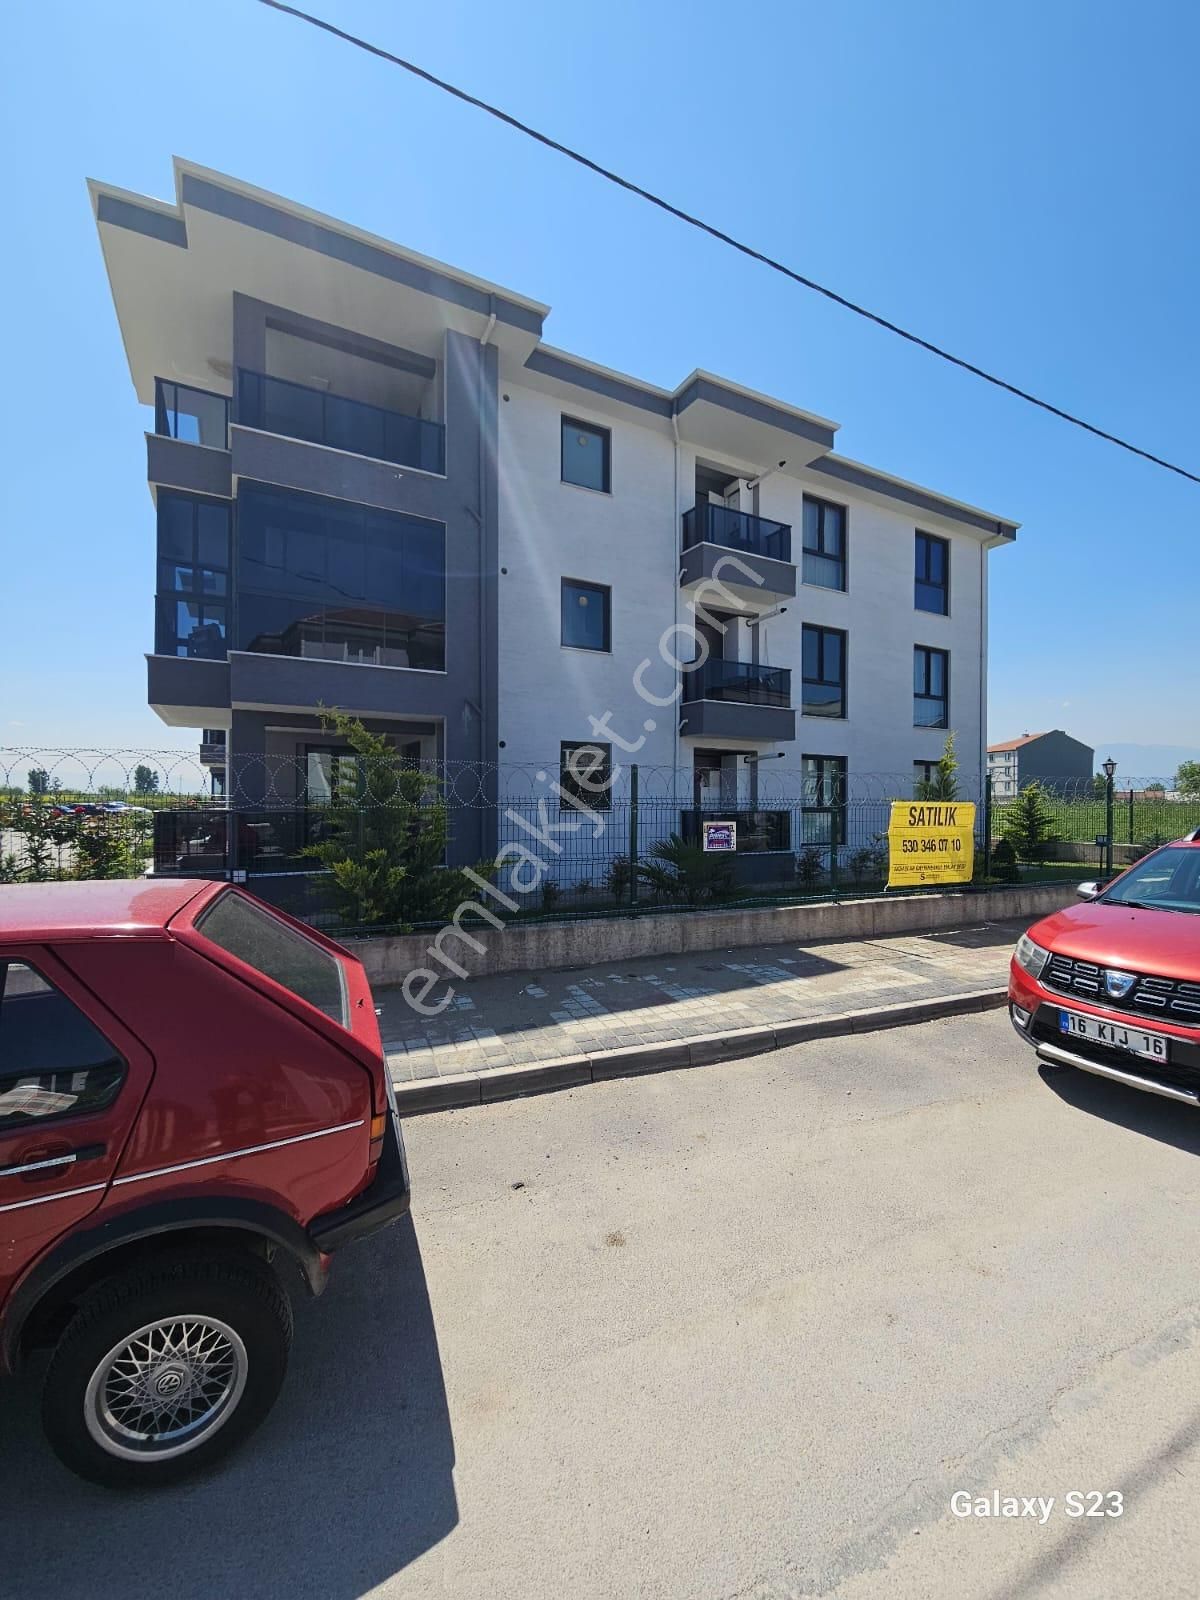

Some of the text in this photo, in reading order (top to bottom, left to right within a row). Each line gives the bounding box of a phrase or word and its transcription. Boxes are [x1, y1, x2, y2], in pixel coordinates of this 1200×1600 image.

[908, 806, 957, 826] SATILIK
[902, 838, 961, 853] 530 346 07 10
[1070, 1016, 1163, 1055] 16 KIJ 16
